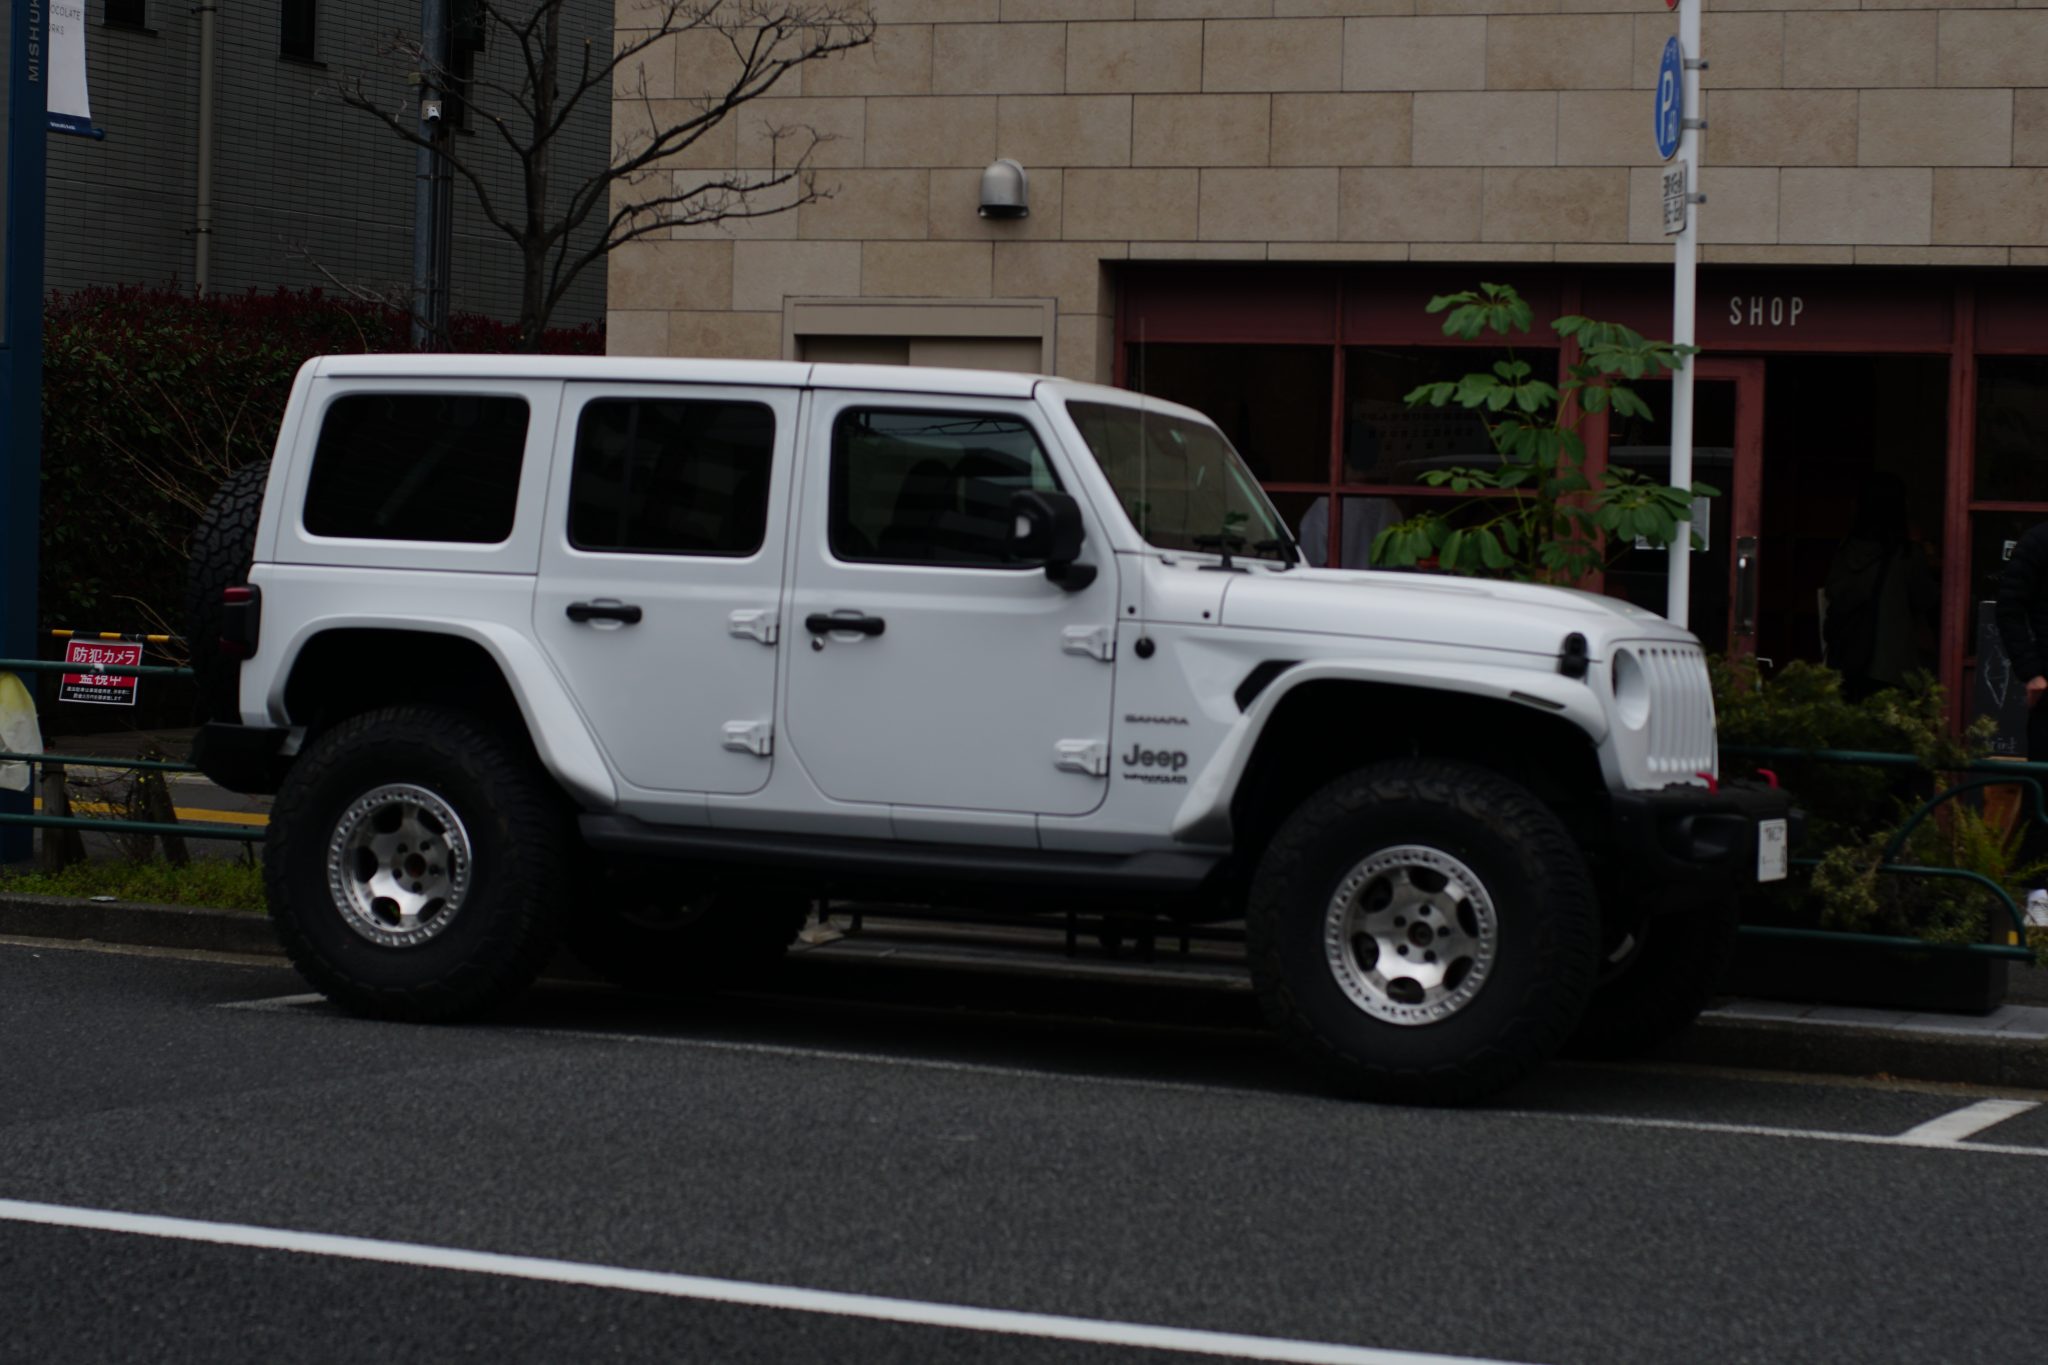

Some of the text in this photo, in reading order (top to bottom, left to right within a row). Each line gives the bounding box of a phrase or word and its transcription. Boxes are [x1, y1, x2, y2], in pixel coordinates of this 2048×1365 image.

[49, 24, 65, 36] RKS
[1660, 70, 1674, 146] P
[1729, 296, 1804, 326] SHOP
[72, 647, 135, 664] 防犯カメラ
[1122, 744, 1188, 772] Jeep
